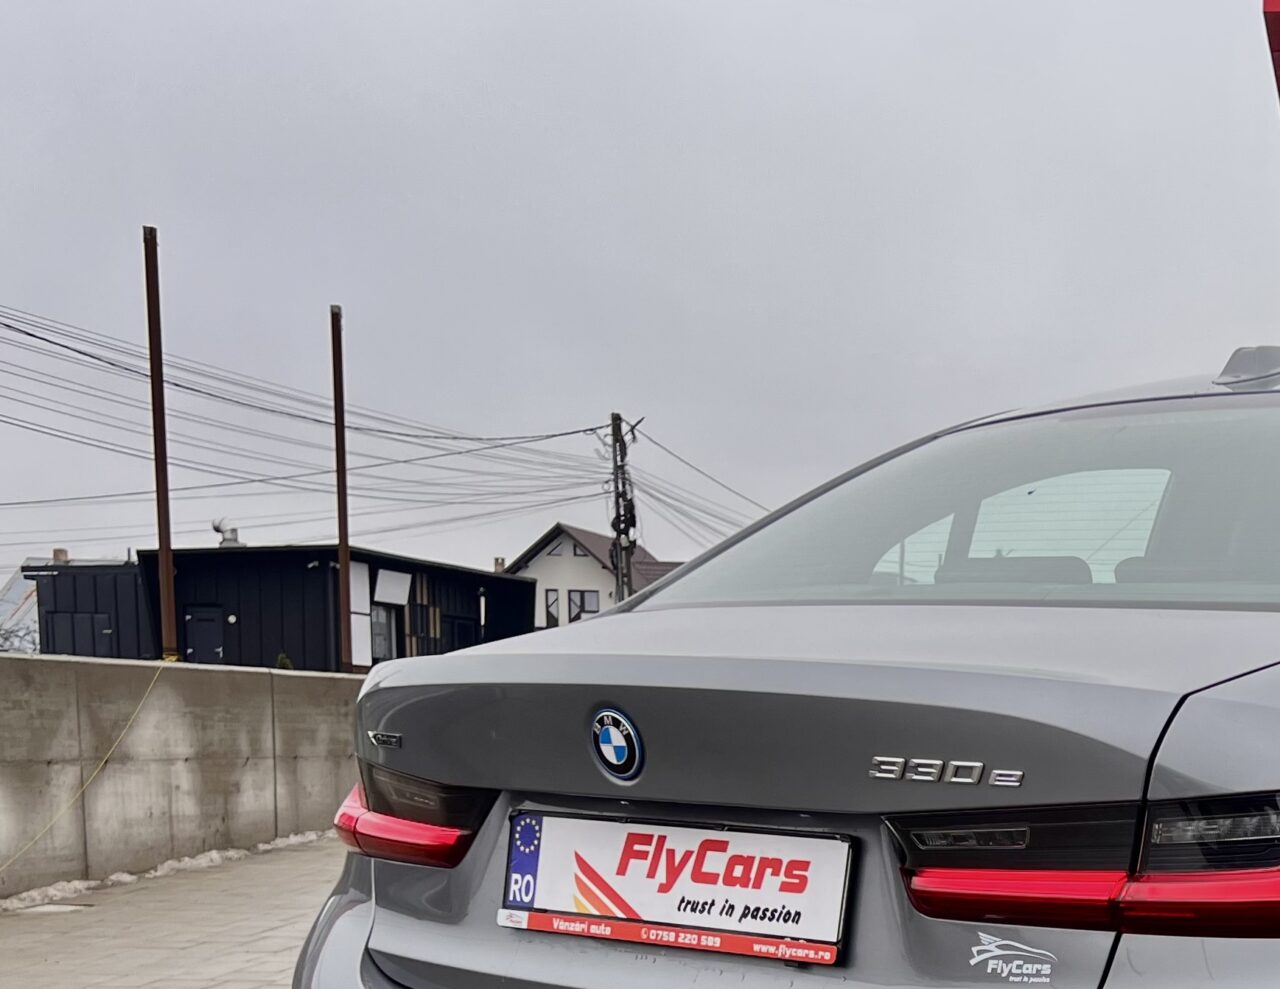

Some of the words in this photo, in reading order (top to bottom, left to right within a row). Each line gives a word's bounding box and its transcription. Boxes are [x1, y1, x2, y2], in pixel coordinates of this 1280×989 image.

[593, 715, 630, 735] BMW
[616, 832, 811, 894] FlyCars
[509, 873, 535, 903] RO
[677, 896, 715, 915] trust
[719, 898, 735, 917] in
[738, 904, 802, 925] passion
[590, 923, 612, 935] auto
[677, 932, 698, 944] 220
[753, 943, 831, 960] www.flycars.ro
[987, 959, 1052, 977] FlyCars
